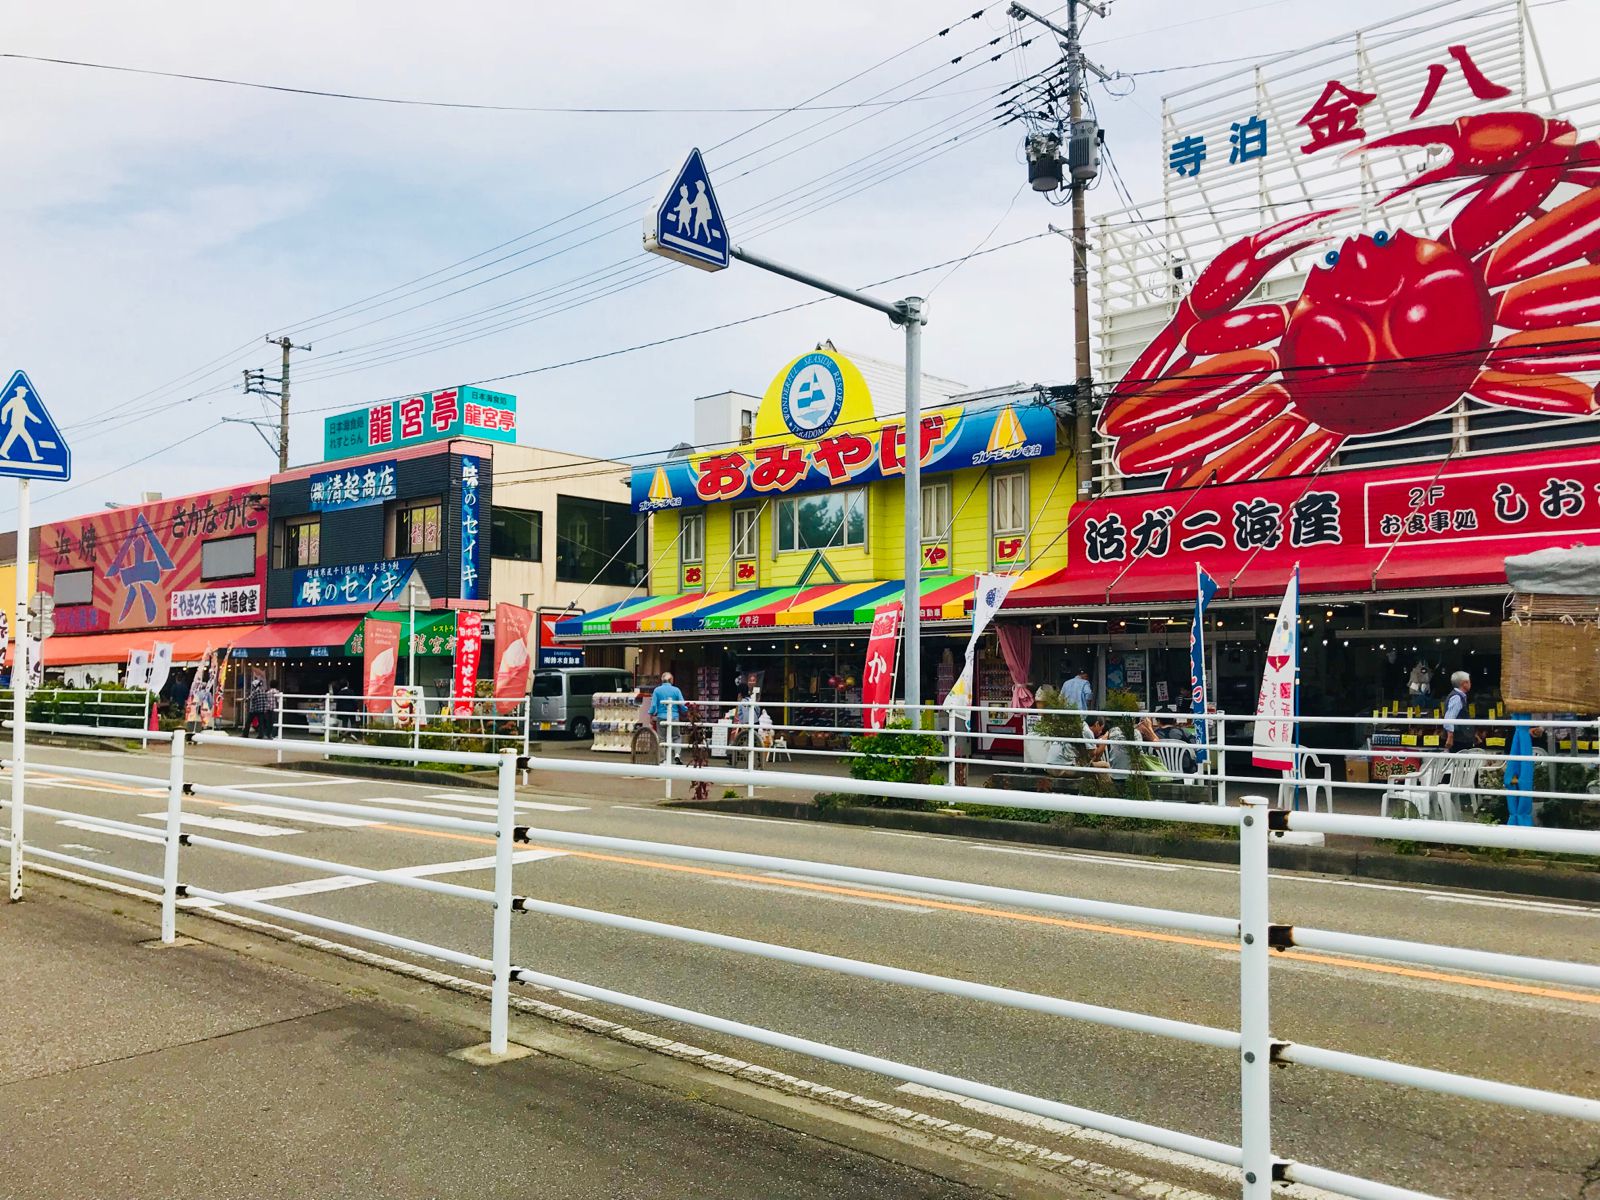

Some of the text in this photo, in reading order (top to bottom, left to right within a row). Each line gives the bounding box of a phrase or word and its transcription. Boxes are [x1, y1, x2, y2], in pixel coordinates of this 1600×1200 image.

[1169, 44, 1512, 177] 寺泊 金八
[804, 355, 833, 368] SEASIDE
[782, 367, 799, 421] WONDERFUL
[833, 371, 843, 408] RESORT
[369, 390, 458, 445] 龍宮亭
[465, 403, 516, 432] 龍宮亭
[697, 414, 946, 500] おみやげ
[1409, 486, 1445, 507] 2F
[1493, 477, 1600, 523] しお
[463, 466, 478, 587] 味のセイキ
[1085, 491, 1342, 562] 活ガニ海産
[1380, 509, 1478, 536] お食事処
[685, 539, 1022, 583] お み や げ
[220, 589, 257, 614] 市場食堂
[302, 572, 400, 605] 味のセイキ
